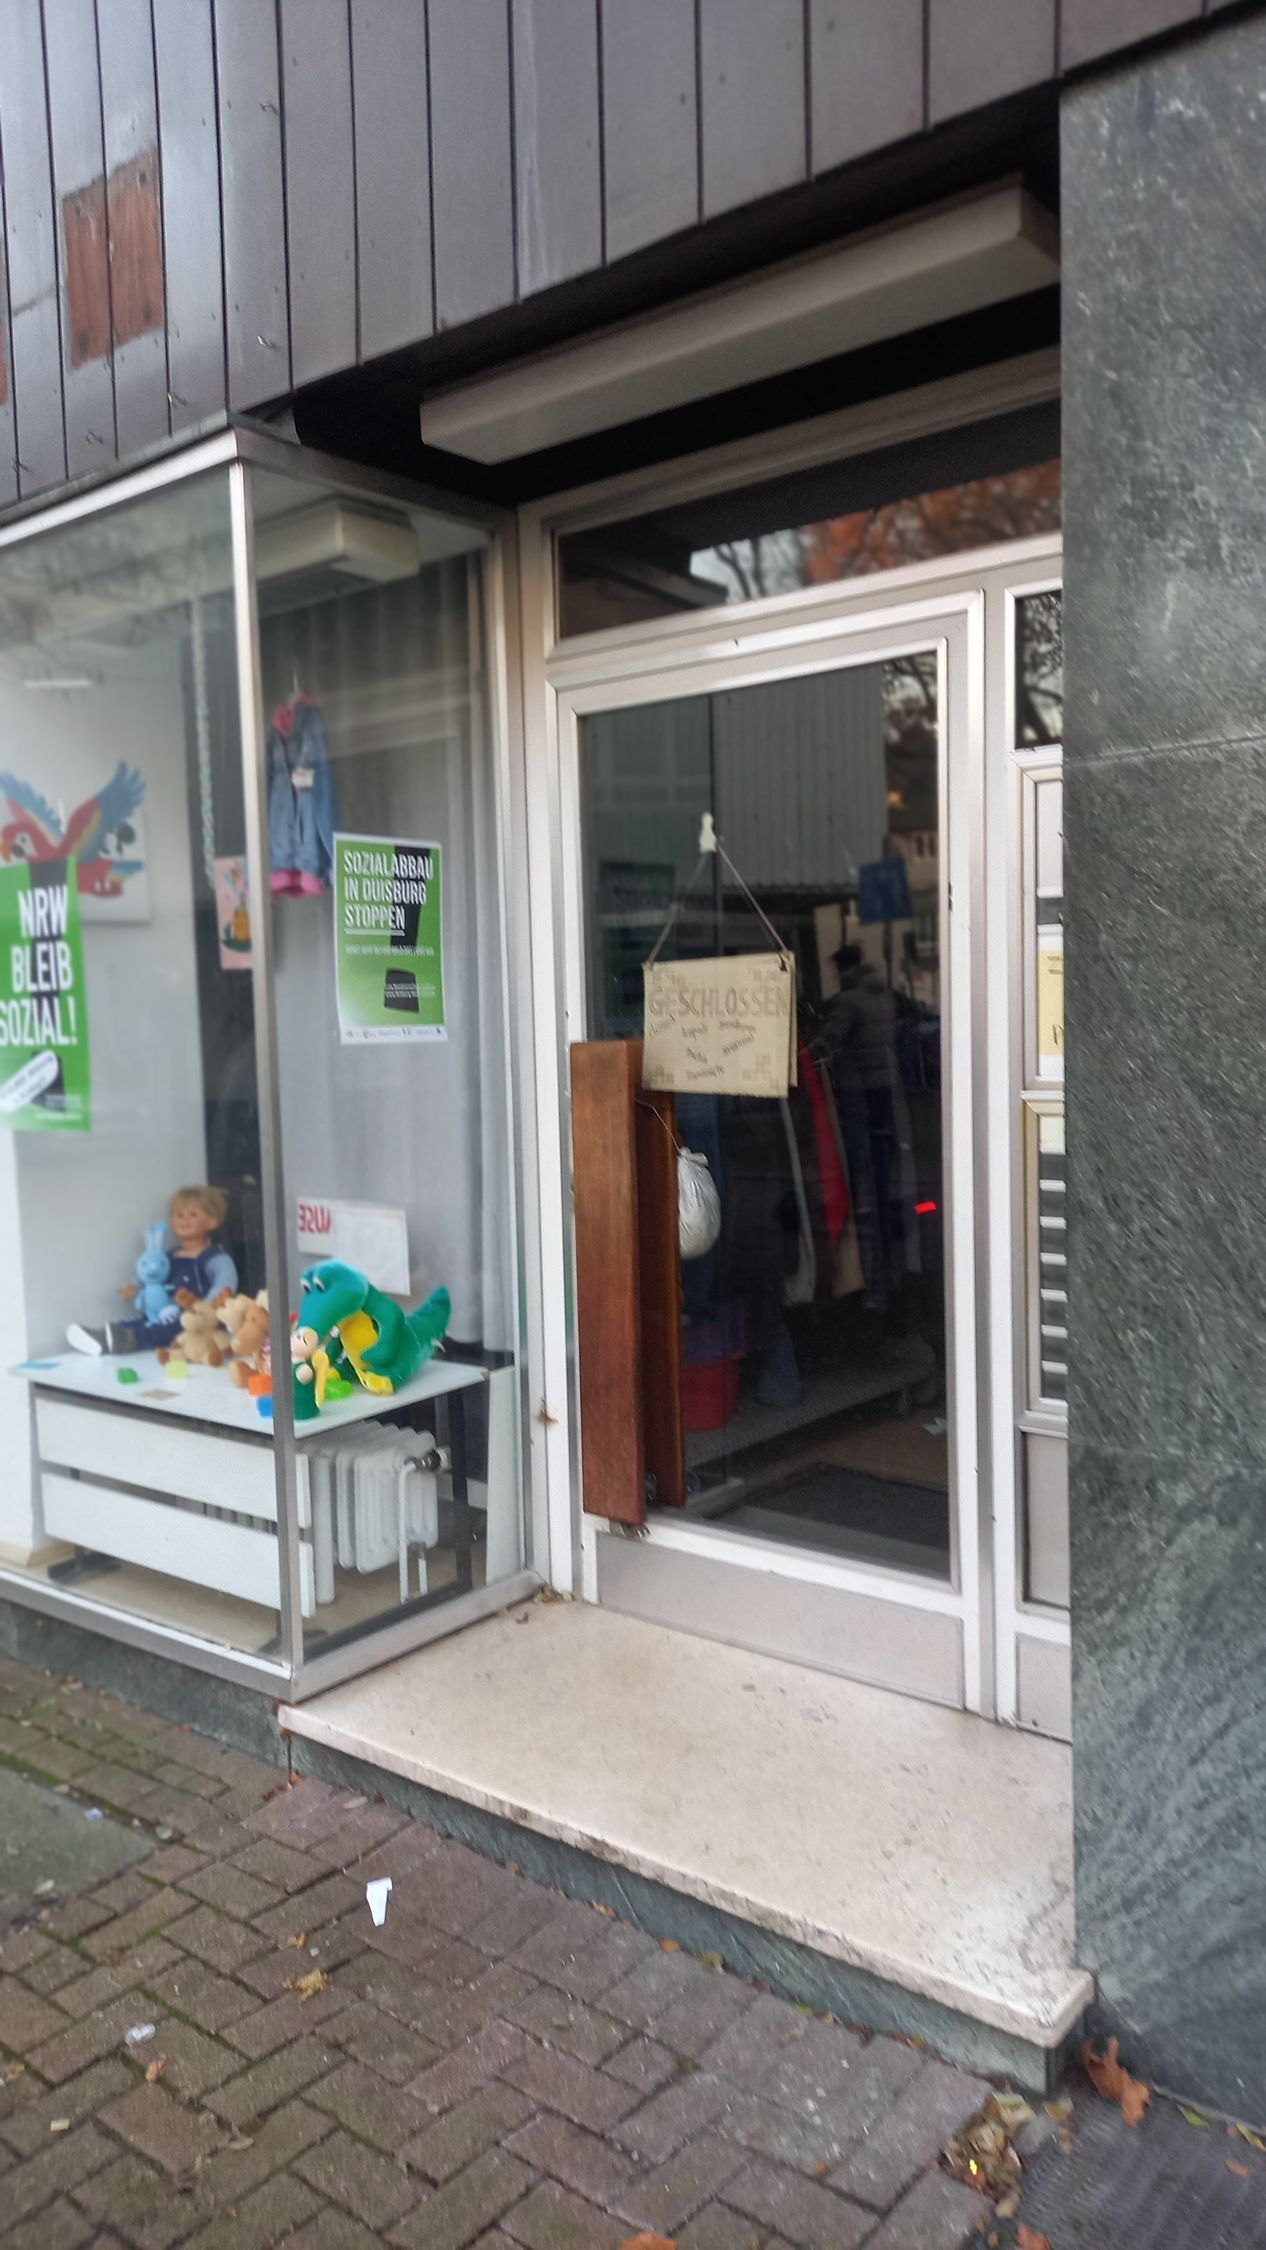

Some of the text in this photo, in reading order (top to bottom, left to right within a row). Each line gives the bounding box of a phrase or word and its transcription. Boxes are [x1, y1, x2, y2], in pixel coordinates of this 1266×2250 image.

[344, 850, 433, 880] SOZIALABBAU
[345, 877, 427, 905] IN DUISBURG
[18, 884, 69, 938] NRW
[345, 904, 406, 930] STOPPEN
[11, 940, 73, 993] BLEIB
[649, 985, 788, 1018] GESCHLOSSEN
[0, 995, 78, 1046] SOZIAL!
